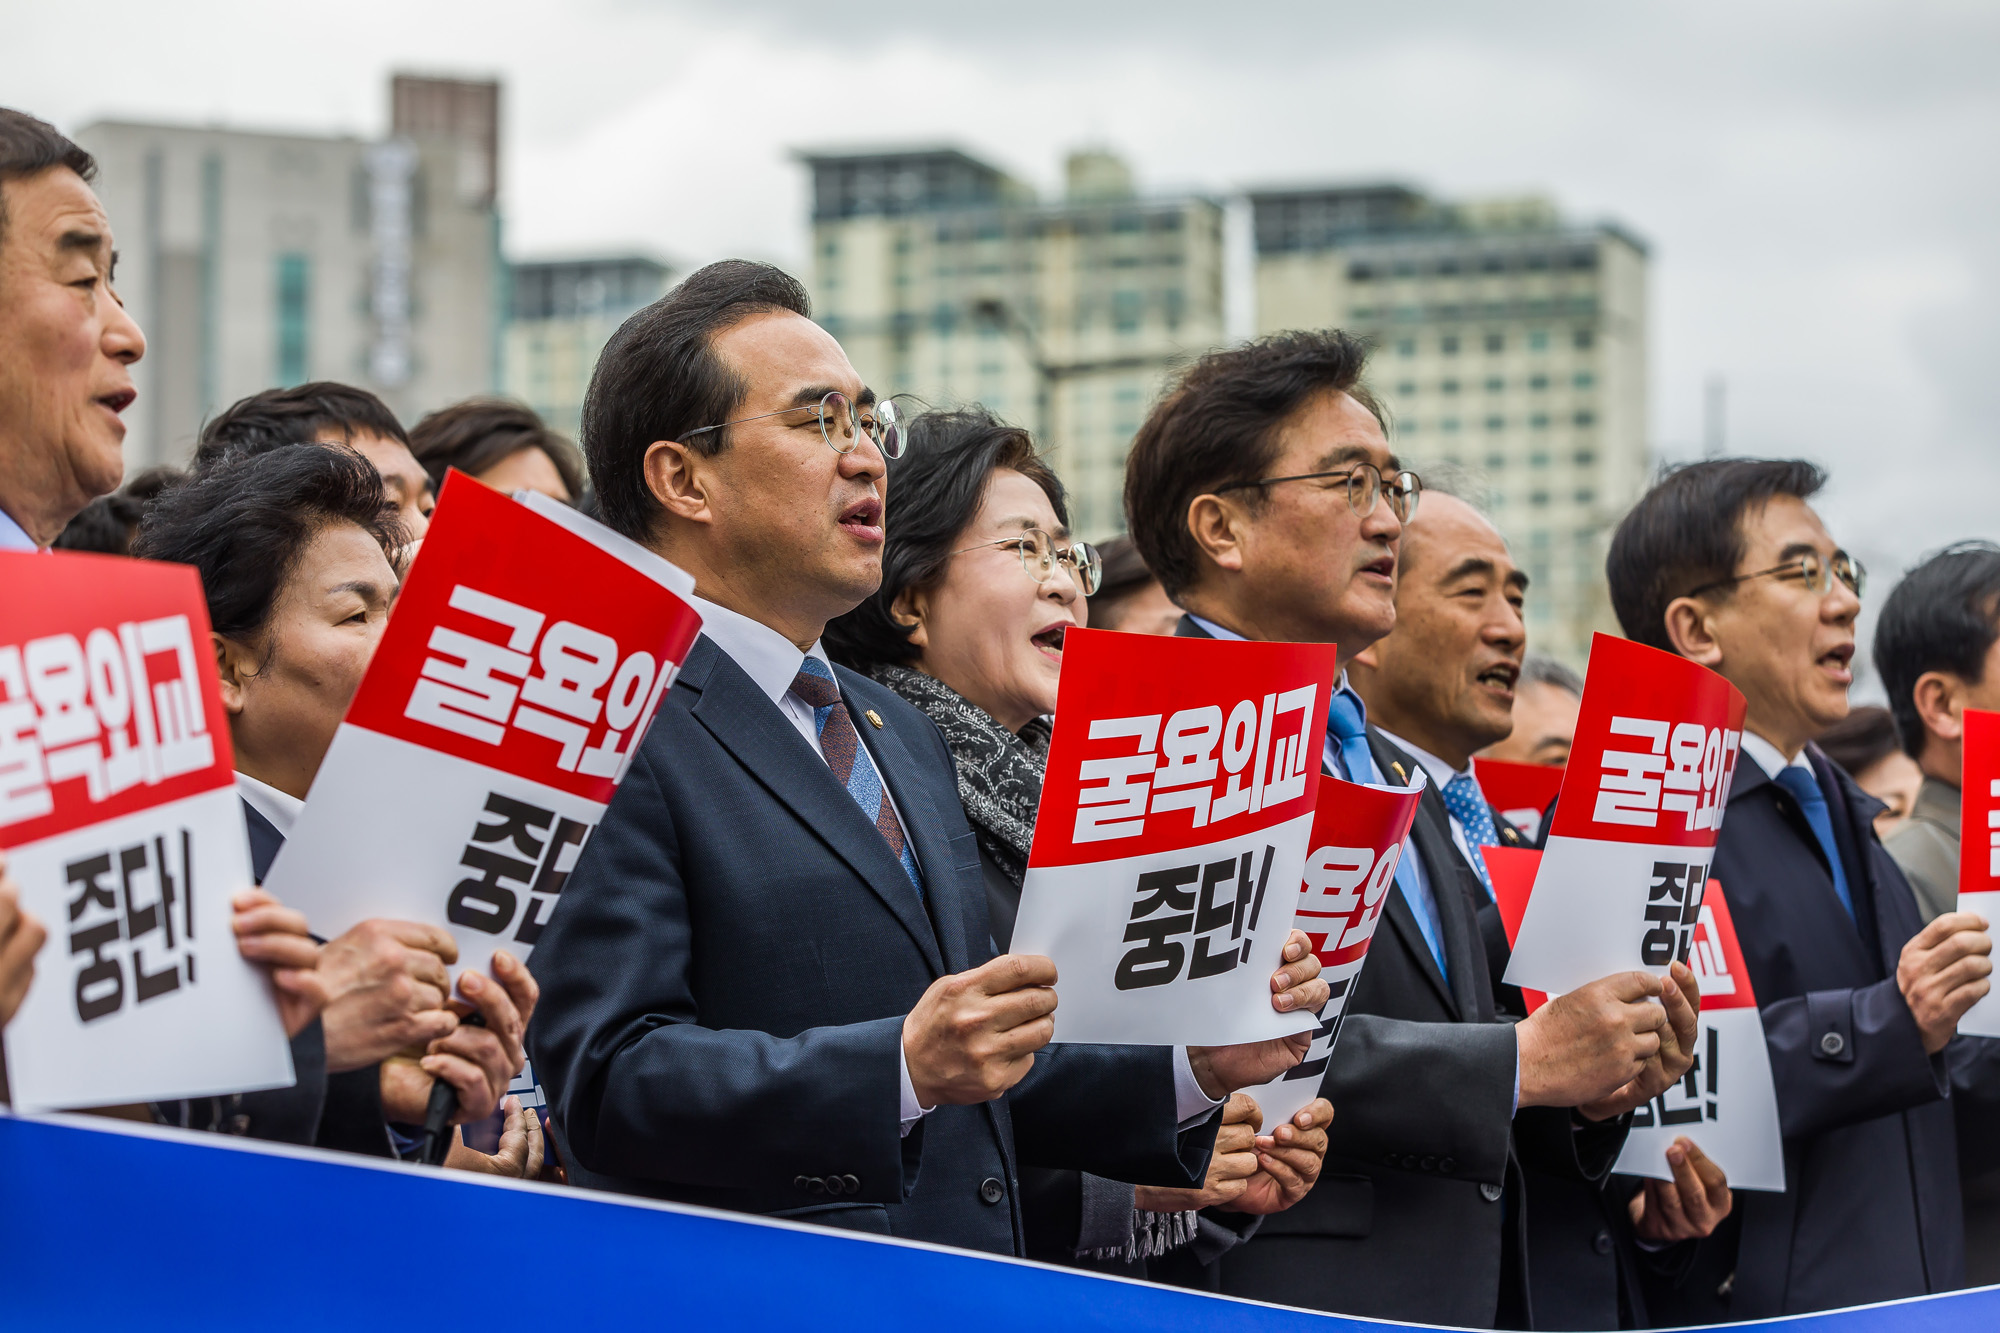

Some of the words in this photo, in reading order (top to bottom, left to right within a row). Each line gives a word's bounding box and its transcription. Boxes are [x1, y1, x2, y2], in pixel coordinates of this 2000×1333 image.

[404, 584, 680, 785] 굴욕외
[1072, 683, 1318, 844] 굴욕외교
[65, 829, 196, 1024] 중단!
[1114, 844, 1275, 991] 중단!
